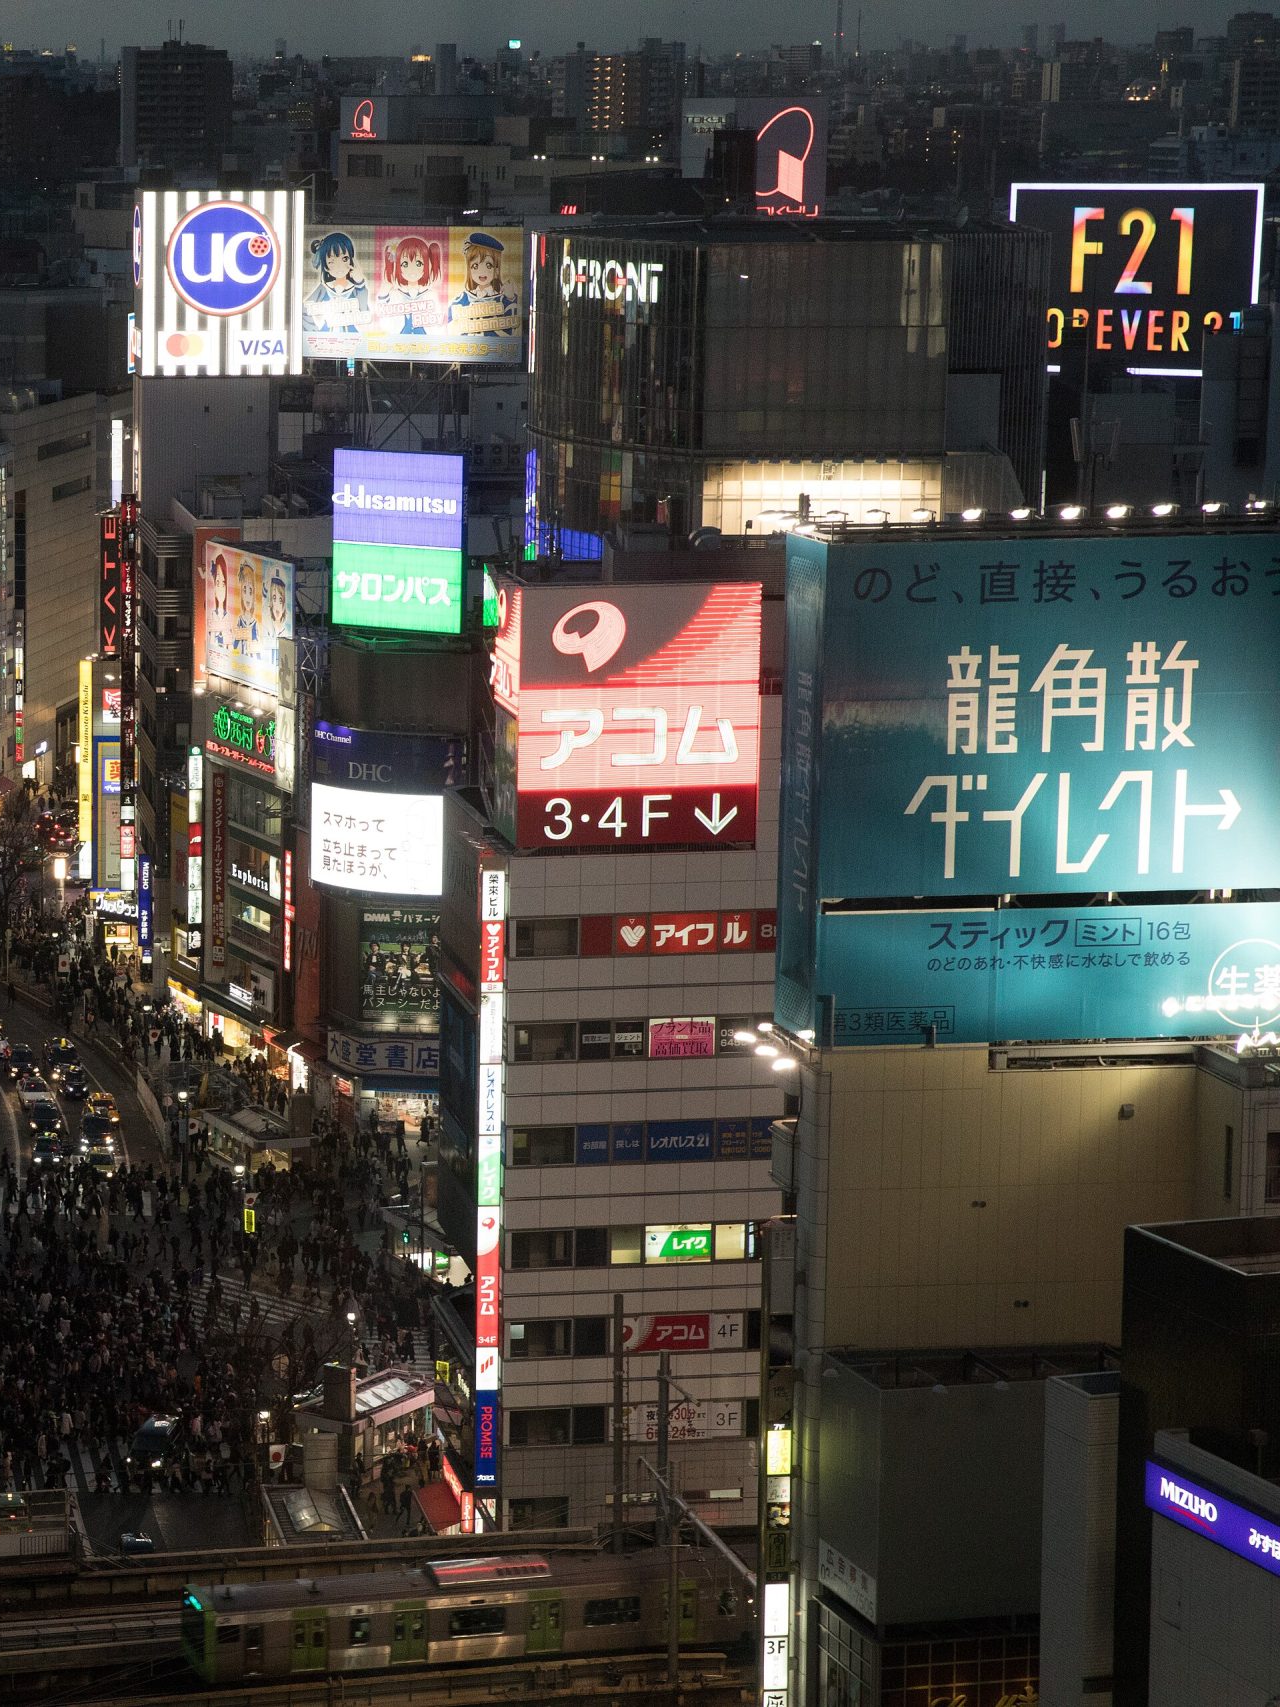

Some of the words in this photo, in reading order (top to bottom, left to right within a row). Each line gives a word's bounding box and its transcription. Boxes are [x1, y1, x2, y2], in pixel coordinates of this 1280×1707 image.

[1069, 207, 1196, 295] F21
[378, 300, 434, 316] Kurosawa
[413, 313, 444, 327] Ruby
[239, 339, 286, 356] VISA
[332, 483, 457, 515] Hisamitsu
[336, 571, 451, 606] サロンパス
[946, 640, 1200, 756] 龍角散
[326, 732, 352, 744] Channel
[540, 705, 740, 770] アコム
[348, 761, 392, 783] DHC
[323, 811, 385, 833] スマホって
[903, 768, 1242, 879] ダイレクト
[322, 838, 398, 861] 立ち止まって
[142, 862, 150, 889] MIZUHO
[231, 863, 269, 891] Euphoria
[322, 855, 388, 879] 見たほうが、
[364, 913, 391, 923] DMM
[655, 921, 747, 946] アイフル
[929, 918, 1068, 950] スティック
[1081, 923, 1135, 943] ミント
[1147, 920, 1191, 941] 16包
[486, 936, 500, 981] アイフル
[927, 948, 1191, 972] のどのあれ・不快感に水なしで飲める
[362, 985, 441, 998] 馬主じゃないよ
[362, 999, 441, 1011] バヌーシーだよ
[654, 1021, 711, 1034] ブランド品
[830, 1010, 951, 1033] 第3類医薬品
[330, 1034, 439, 1069] 大盛堂書店
[655, 1043, 708, 1056] 高価買取
[650, 1133, 710, 1149] レオパレス21
[672, 1236, 707, 1251] レイク
[480, 1275, 495, 1316] アコム
[656, 1324, 705, 1341] アコム
[717, 1323, 739, 1338] 4F
[716, 1412, 738, 1426] 3F
[480, 1406, 493, 1458] PROMISE
[1160, 1476, 1217, 1523] MIZUHO
[767, 1640, 786, 1655] 3F
